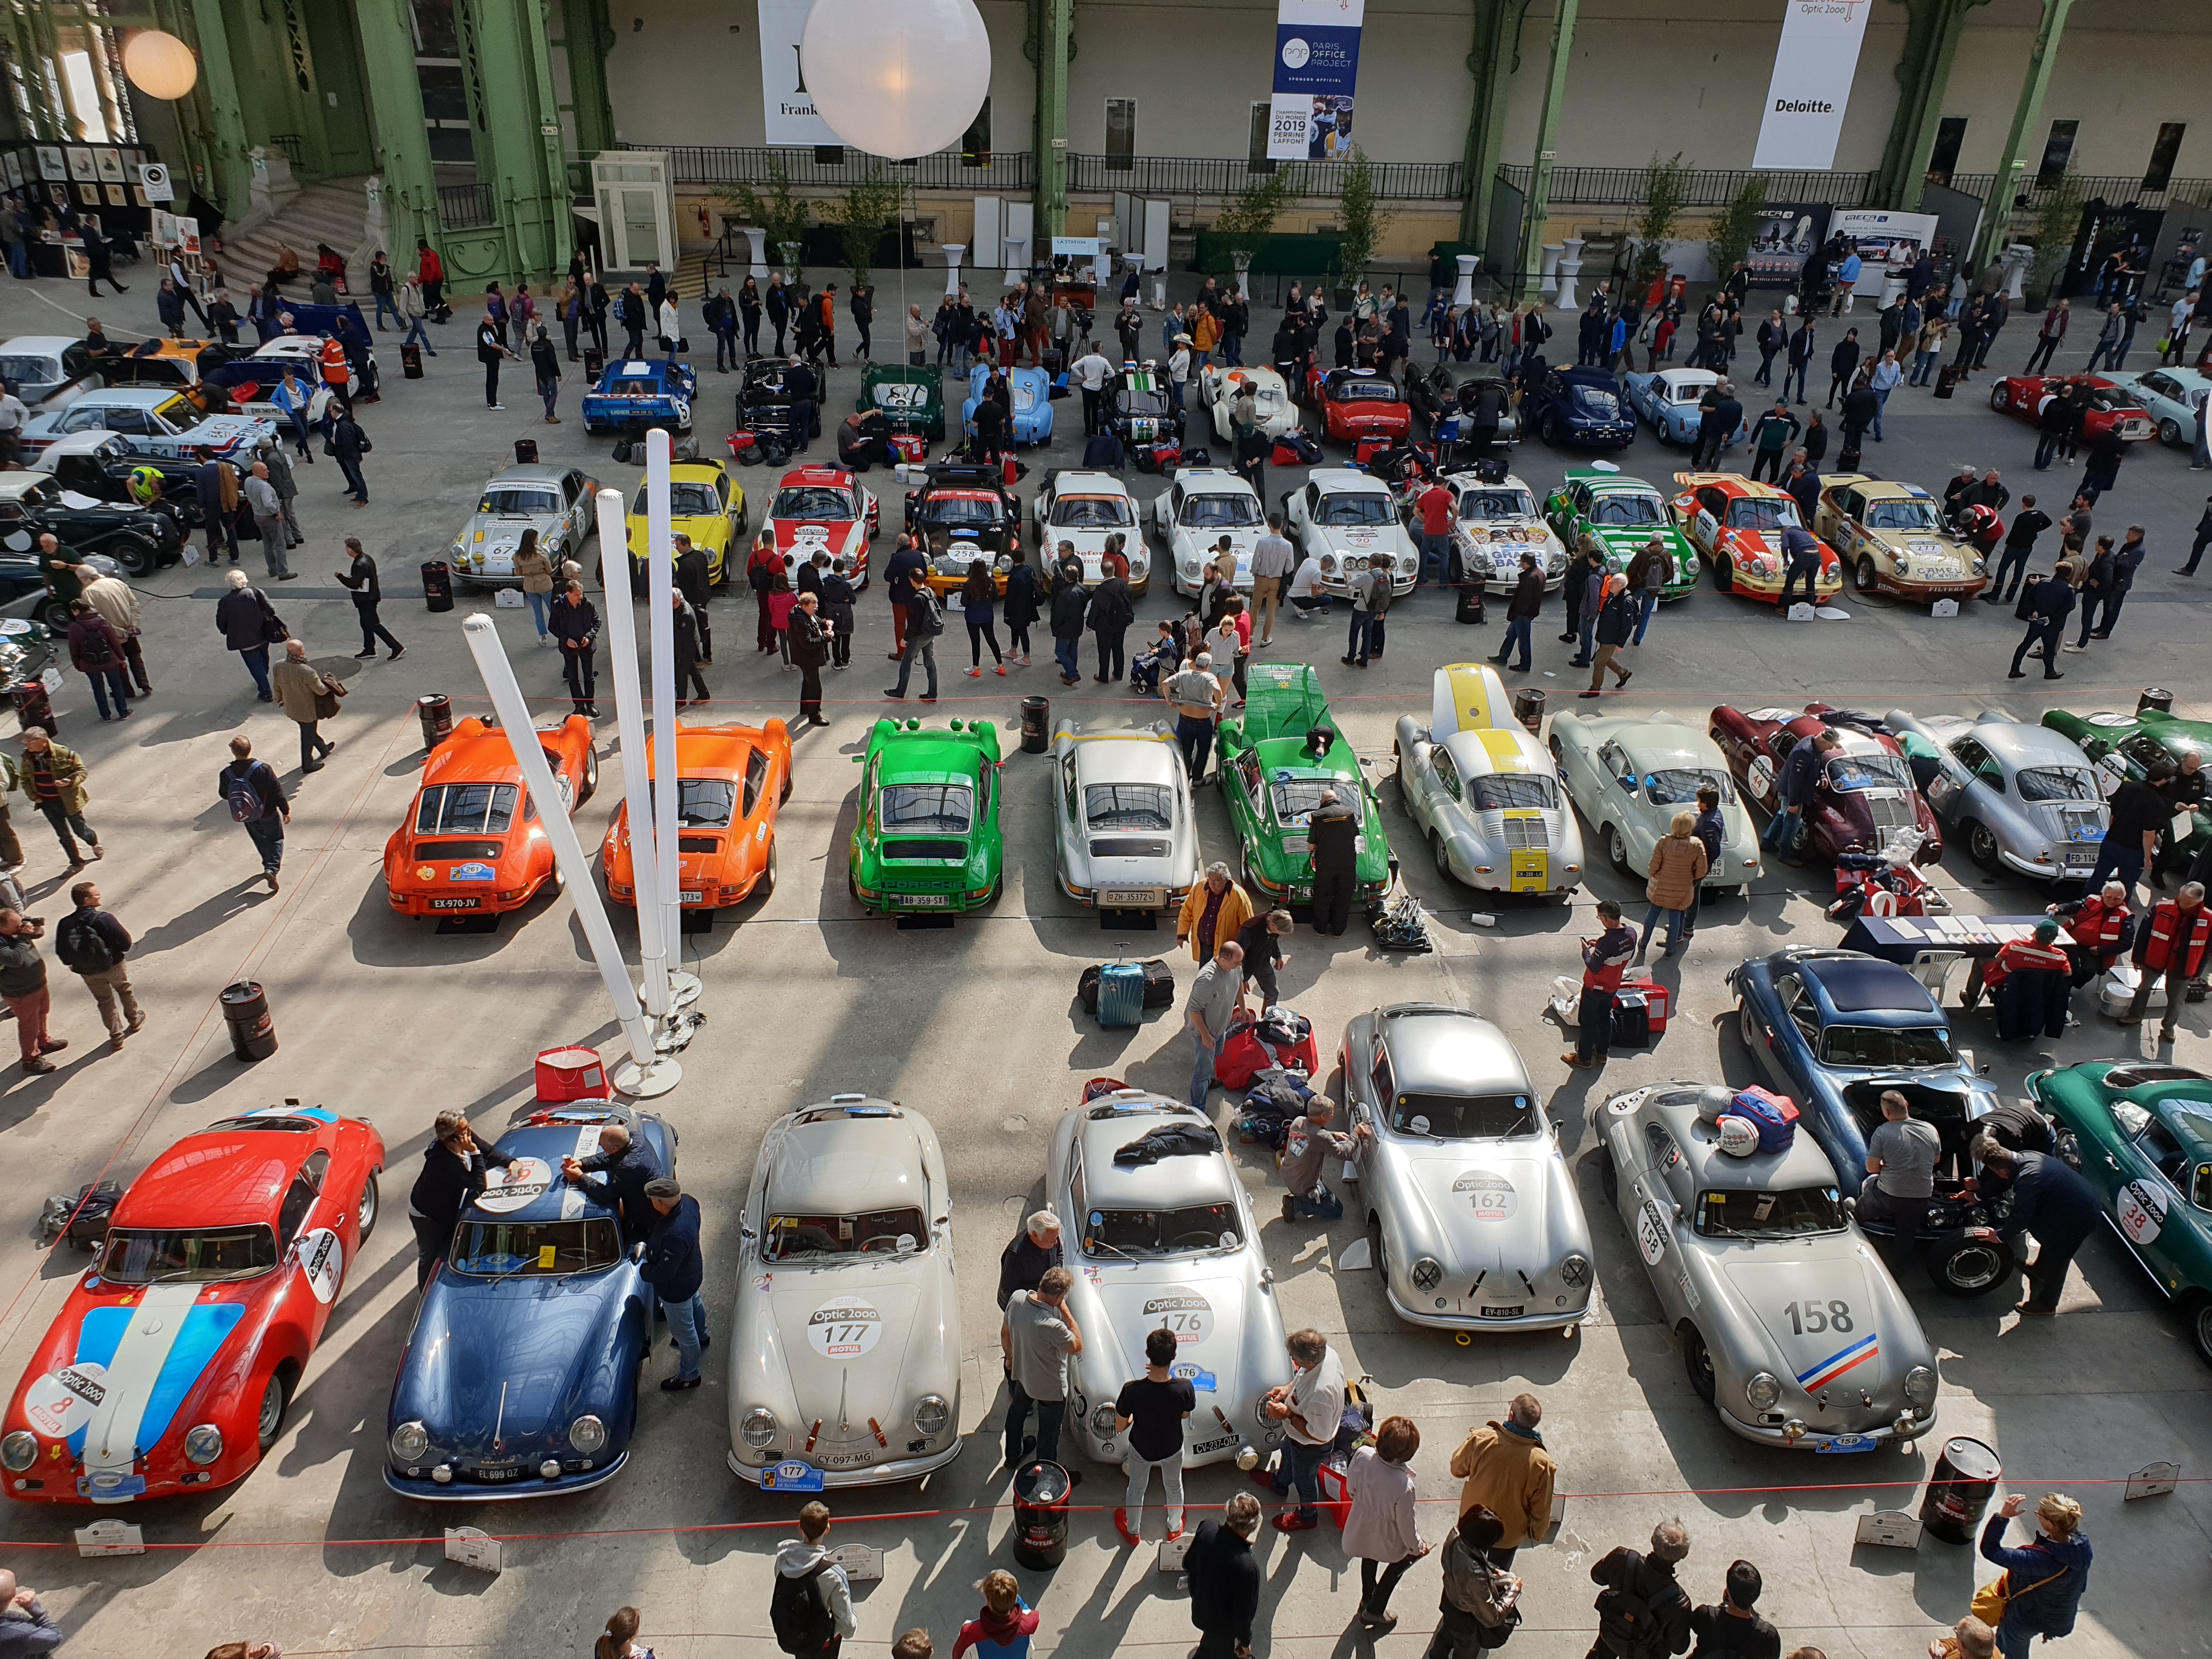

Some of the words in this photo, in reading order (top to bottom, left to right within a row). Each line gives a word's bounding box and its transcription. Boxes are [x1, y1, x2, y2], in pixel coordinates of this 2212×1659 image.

[1801, 4, 1824, 15] Optic
[1825, 4, 1846, 13] 2000
[1313, 42, 1340, 50] PARIS
[1284, 48, 1308, 59] POP
[1312, 50, 1346, 59] OFFICE
[1311, 59, 1352, 67] PROJECT
[1775, 99, 1835, 113] Deloitte.
[1274, 120, 1306, 131] 2019
[678, 403, 687, 420] 5
[236, 423, 261, 438] FINA
[1699, 525, 1707, 539] 266
[1042, 530, 1054, 562] Mondiale
[1838, 534, 1848, 546] 277
[1871, 538, 1892, 555] CAMEL
[1492, 551, 1542, 559] GRAD
[1494, 558, 1544, 567] BAZR
[1879, 583, 1900, 595] Shell
[1753, 758, 1765, 771] Optic
[1761, 768, 1771, 781] 2000
[1940, 768, 1951, 779] 2000
[2101, 757, 2114, 770] Optic
[2111, 766, 2124, 778] 2000
[1753, 774, 1763, 788] 44
[1934, 778, 1942, 788] 4
[2102, 773, 2111, 784] 5
[757, 822, 766, 839] Shell
[885, 878, 963, 889] PORSCHE
[435, 899, 476, 908] EX-970-JV
[481, 1186, 509, 1198] 2000
[510, 1184, 543, 1197] Optic
[1455, 1180, 1483, 1191] Optic
[1485, 1180, 1510, 1189] 2000
[1469, 1193, 1507, 1209] 162
[2129, 1181, 2148, 1203] Optic
[2142, 1197, 2164, 1223] 2000
[1646, 1200, 1660, 1222] Optic
[1654, 1218, 1668, 1243] 2000
[2126, 1204, 2147, 1231] 38
[2122, 1218, 2140, 1240] MOTUL
[1641, 1221, 1658, 1255] 158
[309, 1251, 324, 1278] Optic
[318, 1233, 333, 1256] 2000
[325, 1260, 332, 1280] 8
[1147, 1299, 1179, 1312] Optic
[1180, 1298, 1207, 1308] 2000
[1485, 1307, 1520, 1316] EY-810-SL
[814, 1309, 846, 1323] Optic
[848, 1308, 877, 1320] 2000
[1160, 1313, 1201, 1331] 176
[1784, 1300, 1854, 1335] 158
[824, 1324, 869, 1344] 177
[828, 1345, 861, 1354] MOTUL
[1178, 1369, 1195, 1377] 176
[57, 1368, 83, 1391] Optic
[79, 1381, 105, 1402] 2000
[51, 1396, 74, 1414] 8
[30, 1405, 62, 1434] MOTUL
[1196, 1435, 1236, 1454] CV-237-QM
[817, 1453, 871, 1464] CY-097-MG
[478, 1470, 488, 1479] EL
[489, 1470, 505, 1479] 699
[507, 1468, 518, 1477] QZ
[783, 1466, 802, 1476] 177
[1936, 1501, 1967, 1520] MOTUL
[1024, 1537, 1053, 1547] MOTUL
